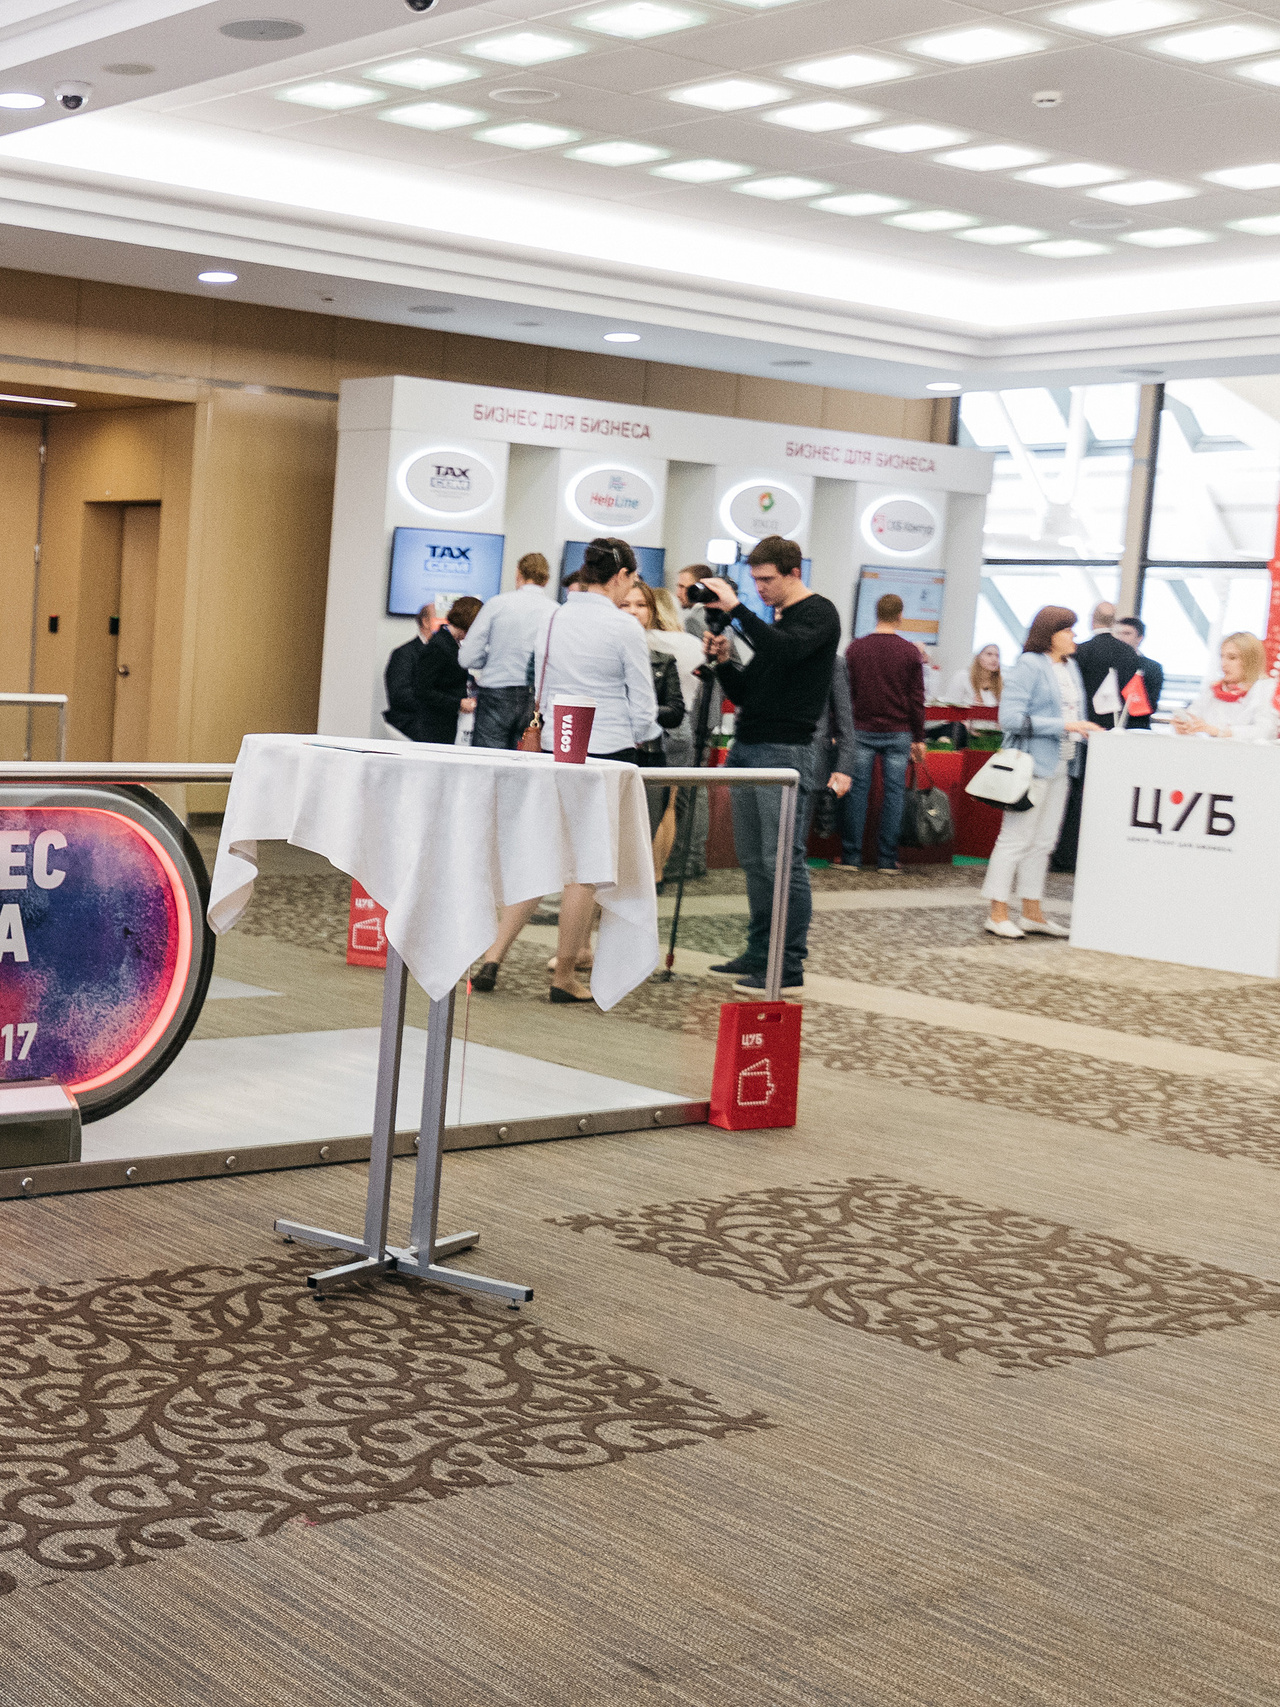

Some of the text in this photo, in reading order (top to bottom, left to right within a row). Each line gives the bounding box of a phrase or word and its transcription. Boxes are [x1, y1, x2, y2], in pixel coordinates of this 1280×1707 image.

[473, 403, 651, 439] БИЗНЕС ДЛЯ БИЗНЕСА
[433, 465, 470, 478] TAX
[786, 441, 936, 473] БИЗНЕС ДЛЯ БИЗНЕСА
[428, 544, 471, 560] TAX
[560, 714, 573, 753] COSTA
[1130, 786, 1236, 836] ЦУБ
[741, 1033, 763, 1047] ЦУБ
